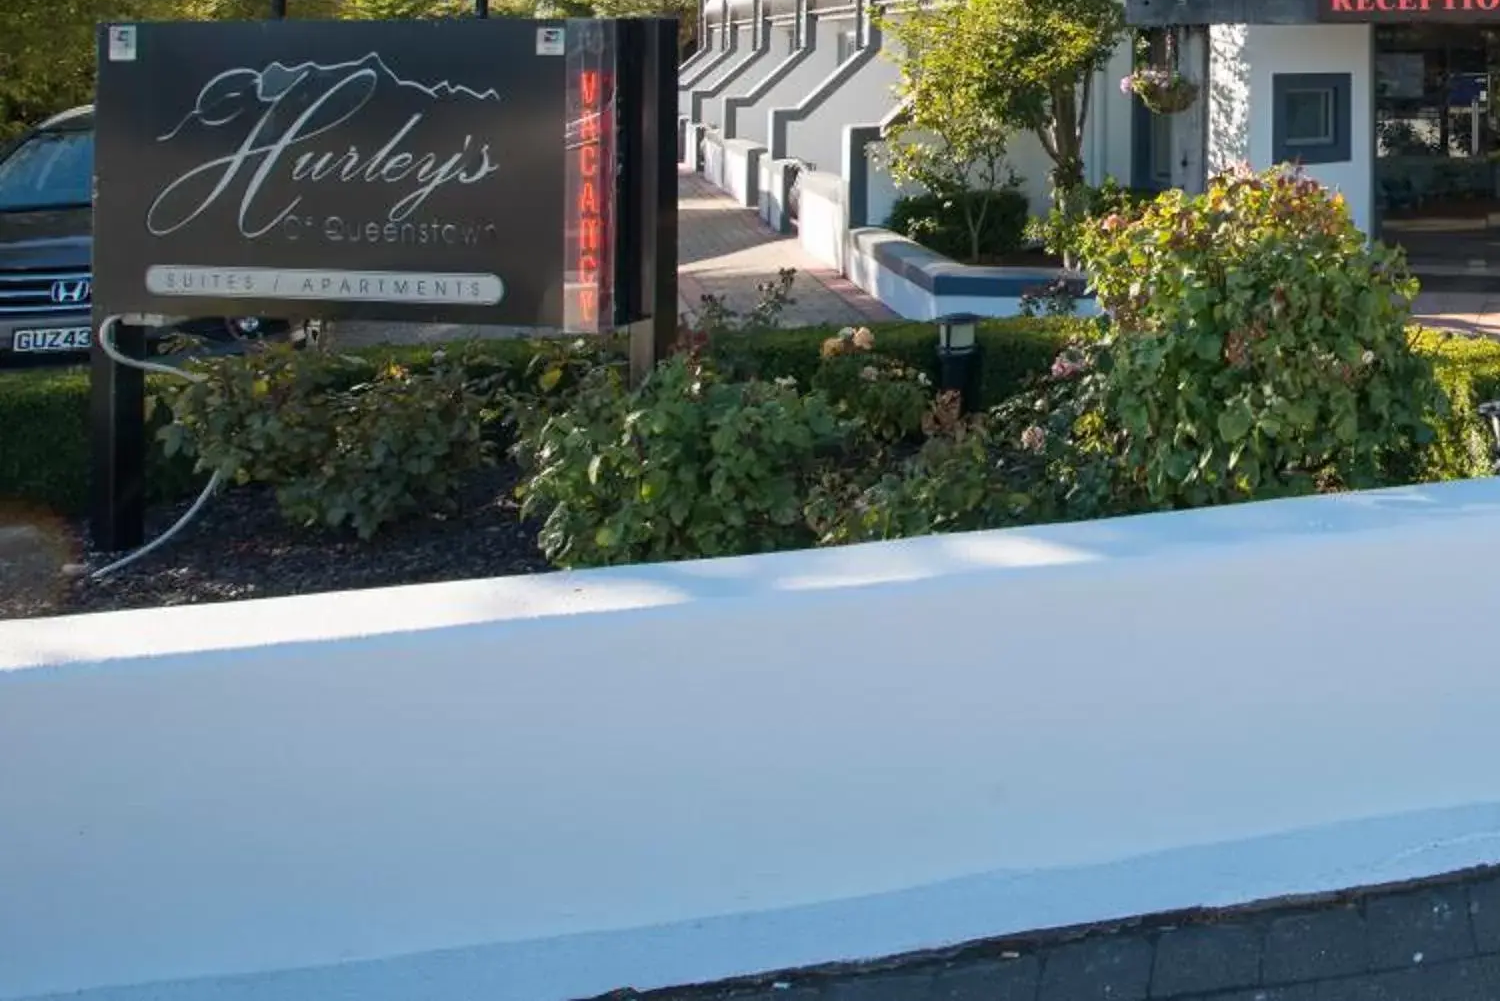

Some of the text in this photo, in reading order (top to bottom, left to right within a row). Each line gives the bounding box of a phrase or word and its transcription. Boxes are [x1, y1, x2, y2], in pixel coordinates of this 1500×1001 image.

[147, 67, 499, 237] Hurley's
[579, 70, 599, 321] VACANCY
[324, 215, 498, 246] Queenstown
[166, 273, 254, 291] SUITES
[302, 277, 482, 297] APARTMENTS
